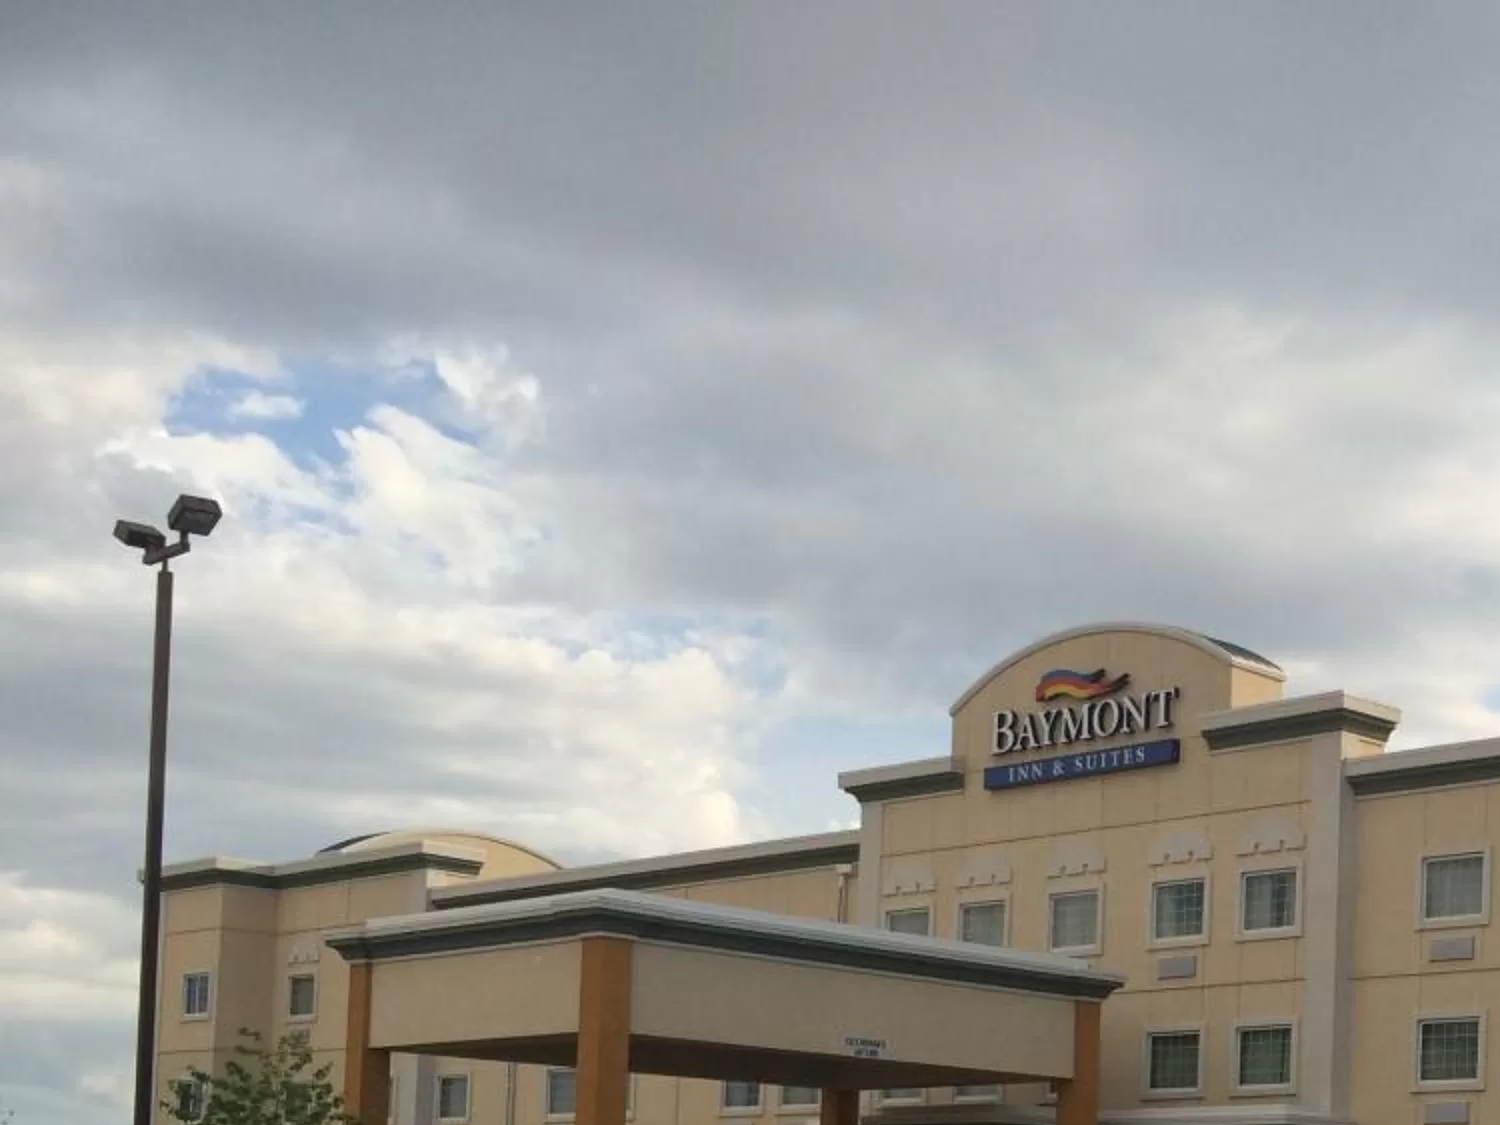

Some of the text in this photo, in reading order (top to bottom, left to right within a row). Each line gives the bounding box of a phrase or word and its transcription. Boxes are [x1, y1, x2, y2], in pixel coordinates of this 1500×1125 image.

[991, 688, 1180, 756] BAYMONT
[1008, 747, 1146, 783] INN & SUITES
